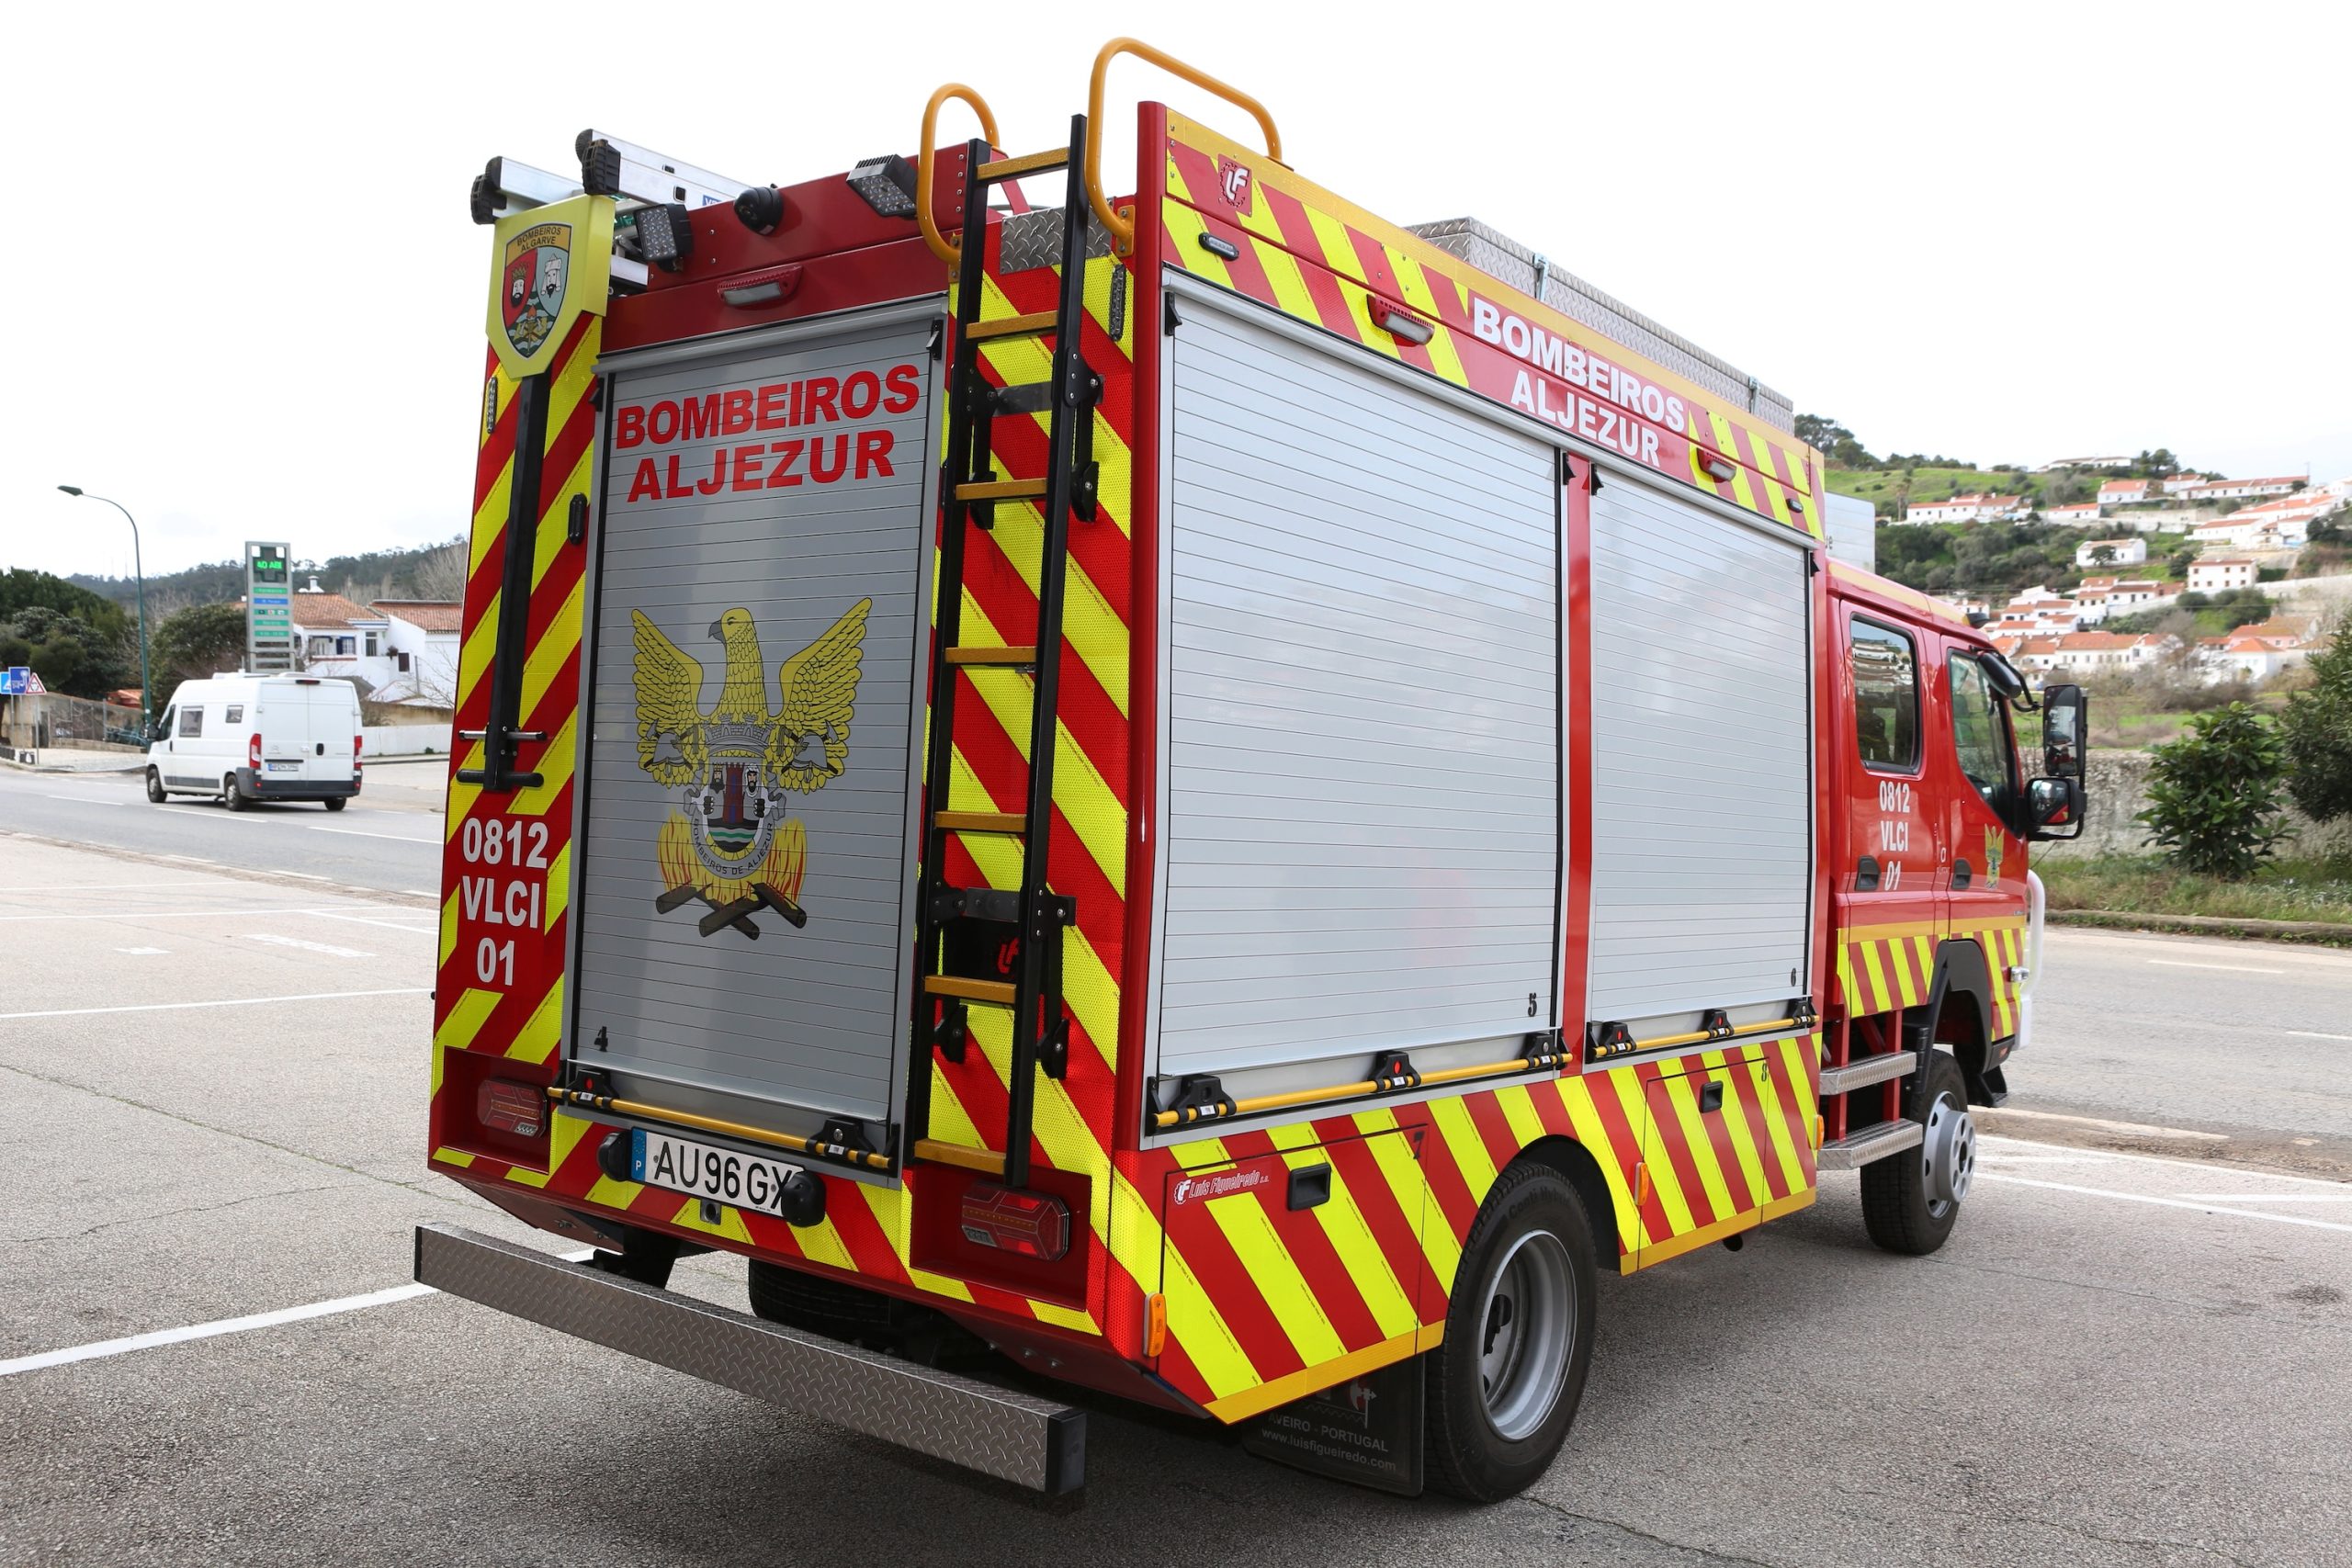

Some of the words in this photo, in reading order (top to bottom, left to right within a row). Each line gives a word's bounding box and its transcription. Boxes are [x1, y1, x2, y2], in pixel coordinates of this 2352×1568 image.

[516, 226, 562, 246] BOMBEIROS
[520, 236, 557, 253] ALGARVE
[1474, 297, 1685, 433] BOMBEIROS
[616, 364, 921, 449] BOMBEIROS
[1510, 369, 1660, 468] ALJEZUR
[626, 429, 896, 503] ALJEZUR
[1879, 780, 1911, 814] 0812
[462, 818, 549, 869] 0812
[693, 818, 729, 874] BOMBEIROS
[731, 865, 743, 875] DE
[747, 822, 773, 871] ALJEZUR
[1880, 819, 1909, 852] VLCI
[1884, 860, 1902, 892] 01
[462, 874, 540, 930] VLCI
[477, 937, 515, 987] 01
[1527, 992, 1538, 1018] 5
[594, 1026, 609, 1053] 4
[1412, 1131, 1425, 1160] 7
[635, 1159, 642, 1172] P
[1209, 1169, 1260, 1194] Figueiredo
[1261, 1427, 1396, 1472] www.luisfigueiredo.com
[1268, 1412, 1311, 1433] AVEIRO
[1321, 1425, 1389, 1453] PORTUGAL
